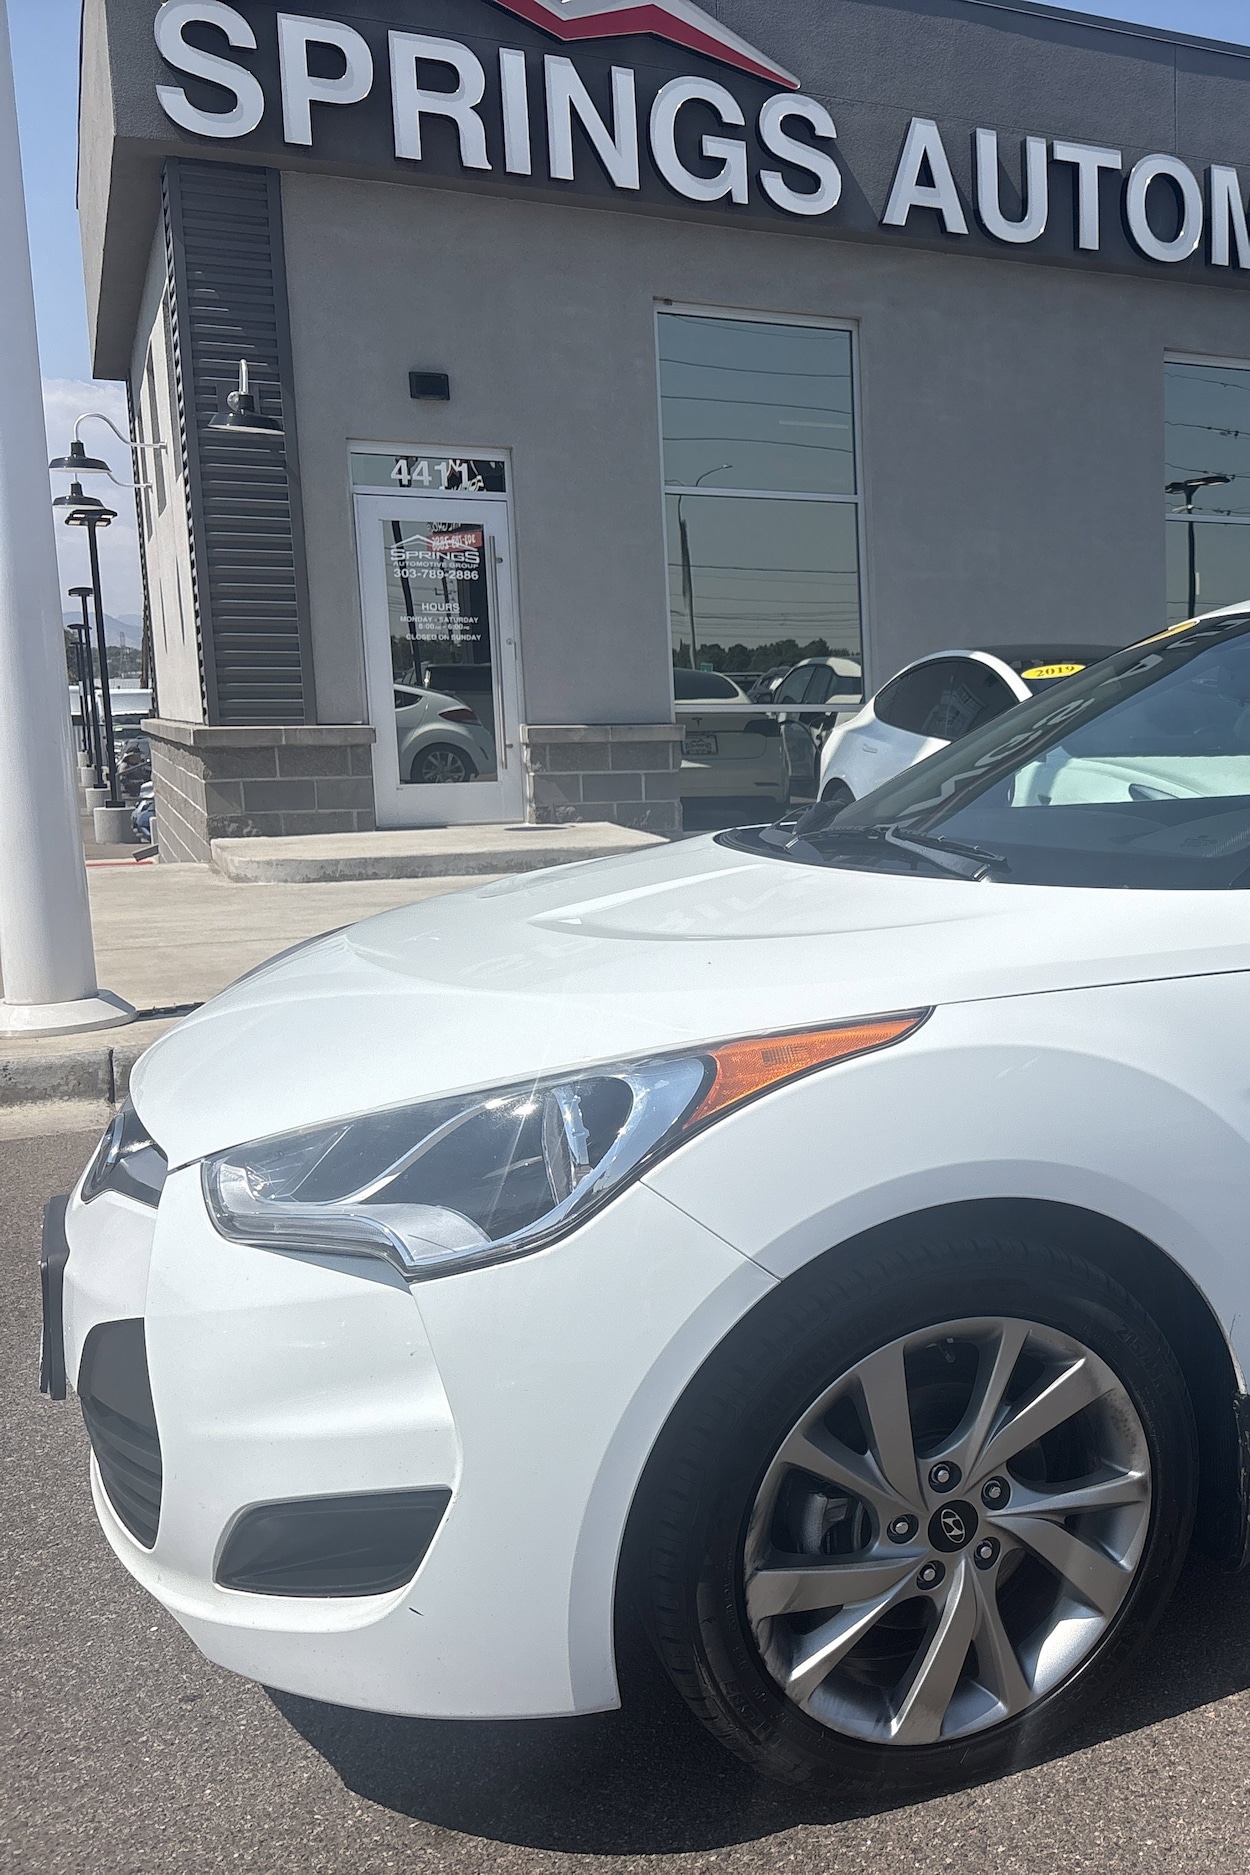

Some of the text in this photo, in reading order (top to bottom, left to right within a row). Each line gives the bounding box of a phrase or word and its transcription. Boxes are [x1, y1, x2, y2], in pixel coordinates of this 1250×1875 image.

[153, 0, 843, 217] SPRINGS
[390, 459, 469, 487] 4411
[390, 548, 480, 564] SPRINGS
[393, 568, 479, 580] 303-789-2886
[421, 602, 460, 612] HOURS
[406, 633, 437, 641] CLOSED
[1036, 666, 1075, 677] 2019
